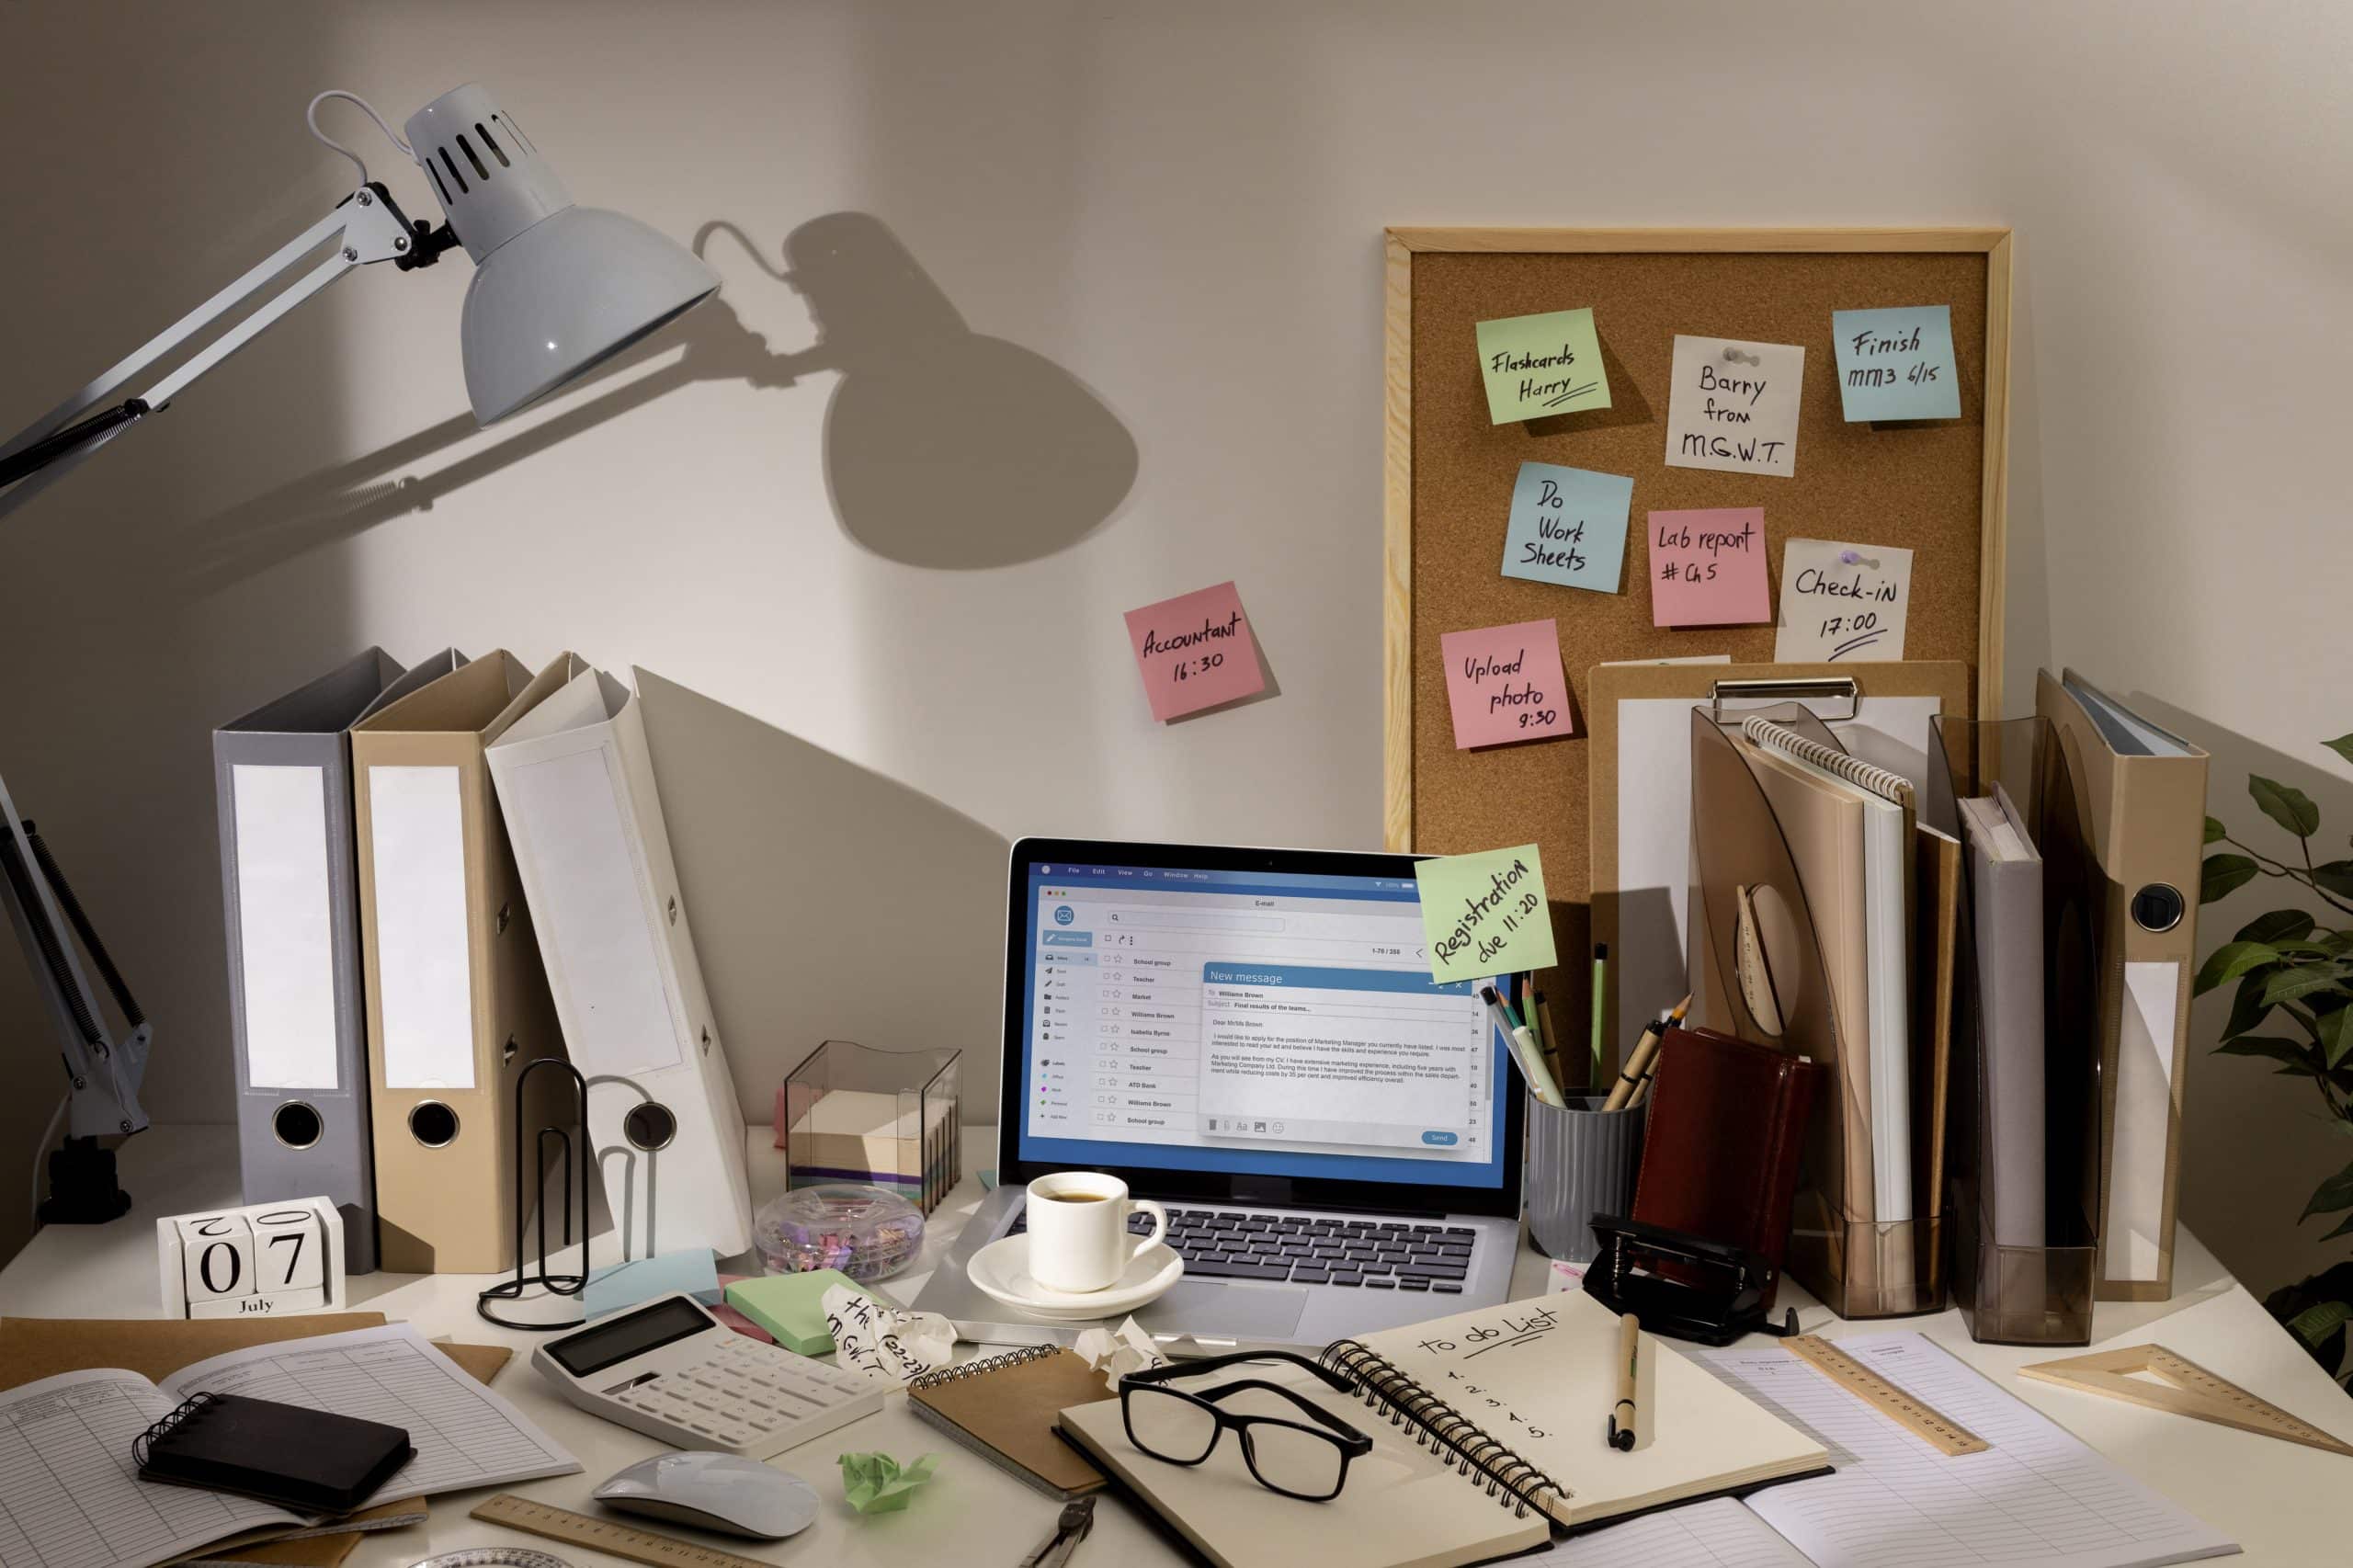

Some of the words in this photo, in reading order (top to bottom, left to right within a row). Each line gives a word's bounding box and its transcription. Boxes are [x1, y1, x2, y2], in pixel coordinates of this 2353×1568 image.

[1852, 326, 1921, 357] Finish
[1491, 344, 1574, 374] Flashcards
[1906, 361, 1941, 386] 6/15
[1518, 376, 1572, 403] Harry
[1699, 366, 1767, 405] Barry
[1704, 398, 1751, 425] from
[1537, 480, 1563, 510] Do
[1539, 517, 1585, 543] Work
[1658, 526, 1691, 549] Lab
[1699, 522, 1756, 558] report
[1520, 540, 1586, 572] Sheets
[1661, 562, 1679, 581] #
[1142, 610, 1243, 658] Accountant
[1820, 612, 1877, 639] 17:00
[1173, 653, 1224, 683] 16:30
[1463, 650, 1524, 679] Upload
[1489, 683, 1544, 714] photo
[1518, 708, 1557, 729] 9:30
[1435, 858, 1529, 965] Registration
[1478, 935, 1507, 963] due
[1503, 892, 1539, 933] 11:20
[1210, 971, 1233, 982] New
[1235, 973, 1283, 985] message
[1431, 1133, 1449, 1142] Send
[238, 1299, 274, 1313] July
[1465, 1325, 1499, 1344] do
